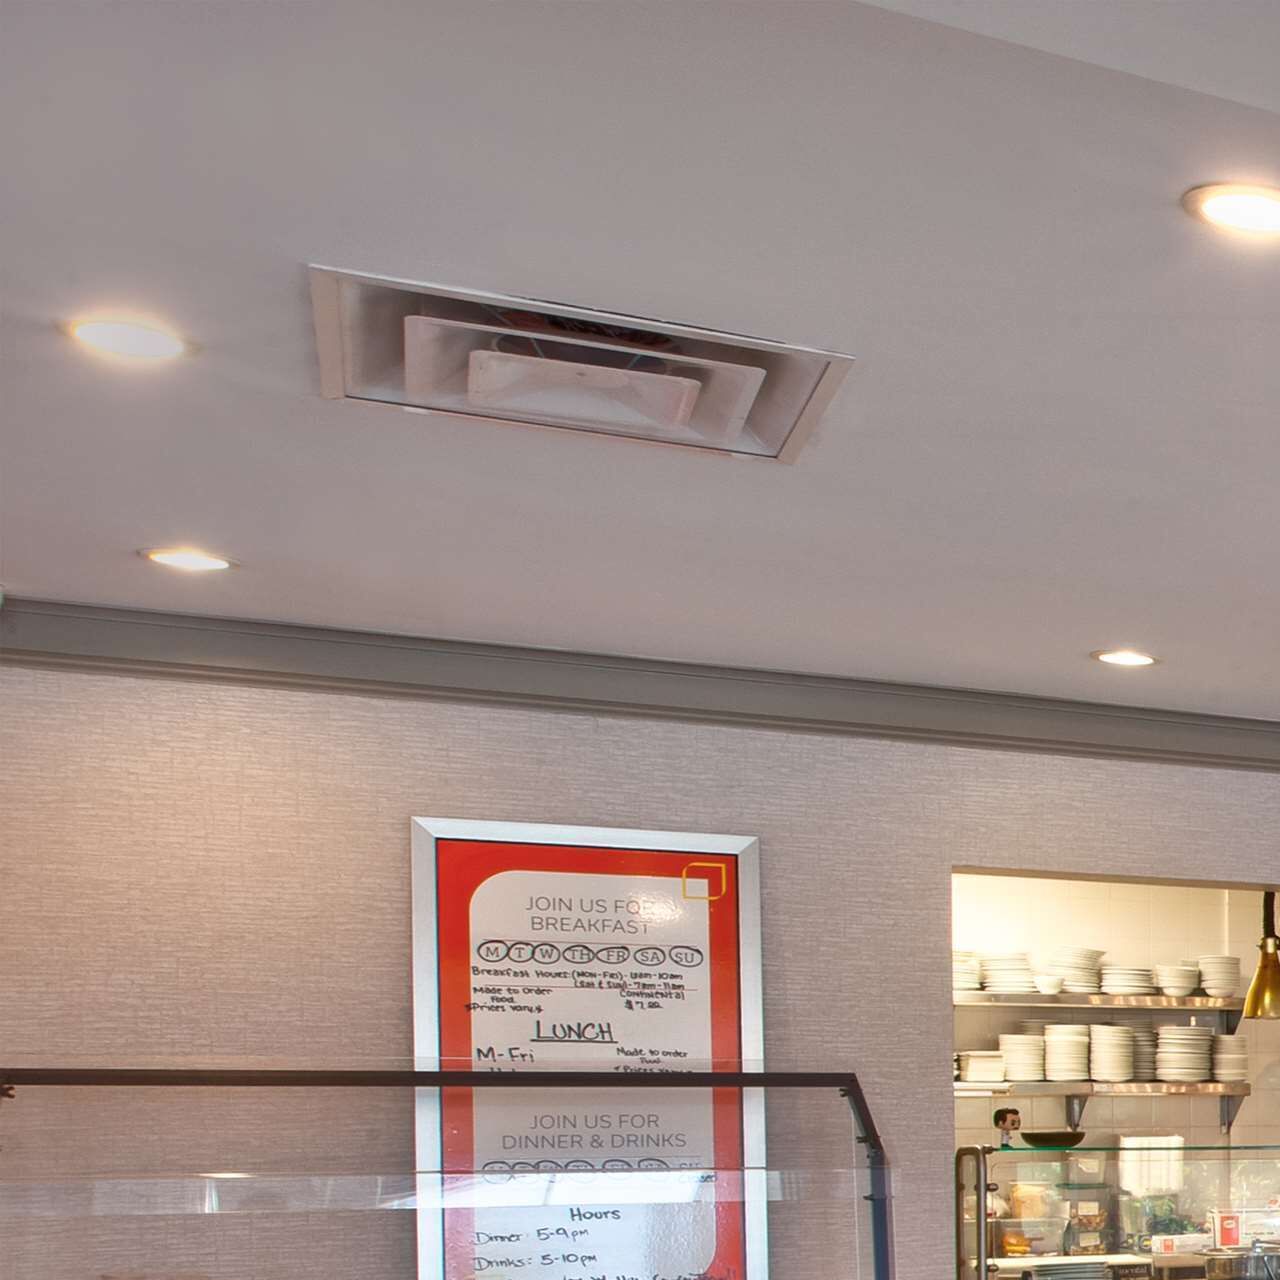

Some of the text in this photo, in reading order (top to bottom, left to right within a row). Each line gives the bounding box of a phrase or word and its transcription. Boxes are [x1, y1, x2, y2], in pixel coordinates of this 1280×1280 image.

[525, 896, 654, 915] JOIN US FO
[531, 916, 652, 934] BREAKFAST
[485, 946, 695, 963] M T W TH FR SA SU
[472, 966, 530, 978] Breakfast
[507, 987, 519, 995] to
[530, 1114, 660, 1130] JOIN US FOR
[502, 1133, 687, 1150] DINNER & DRINKS
[570, 1207, 621, 1222] Hours
